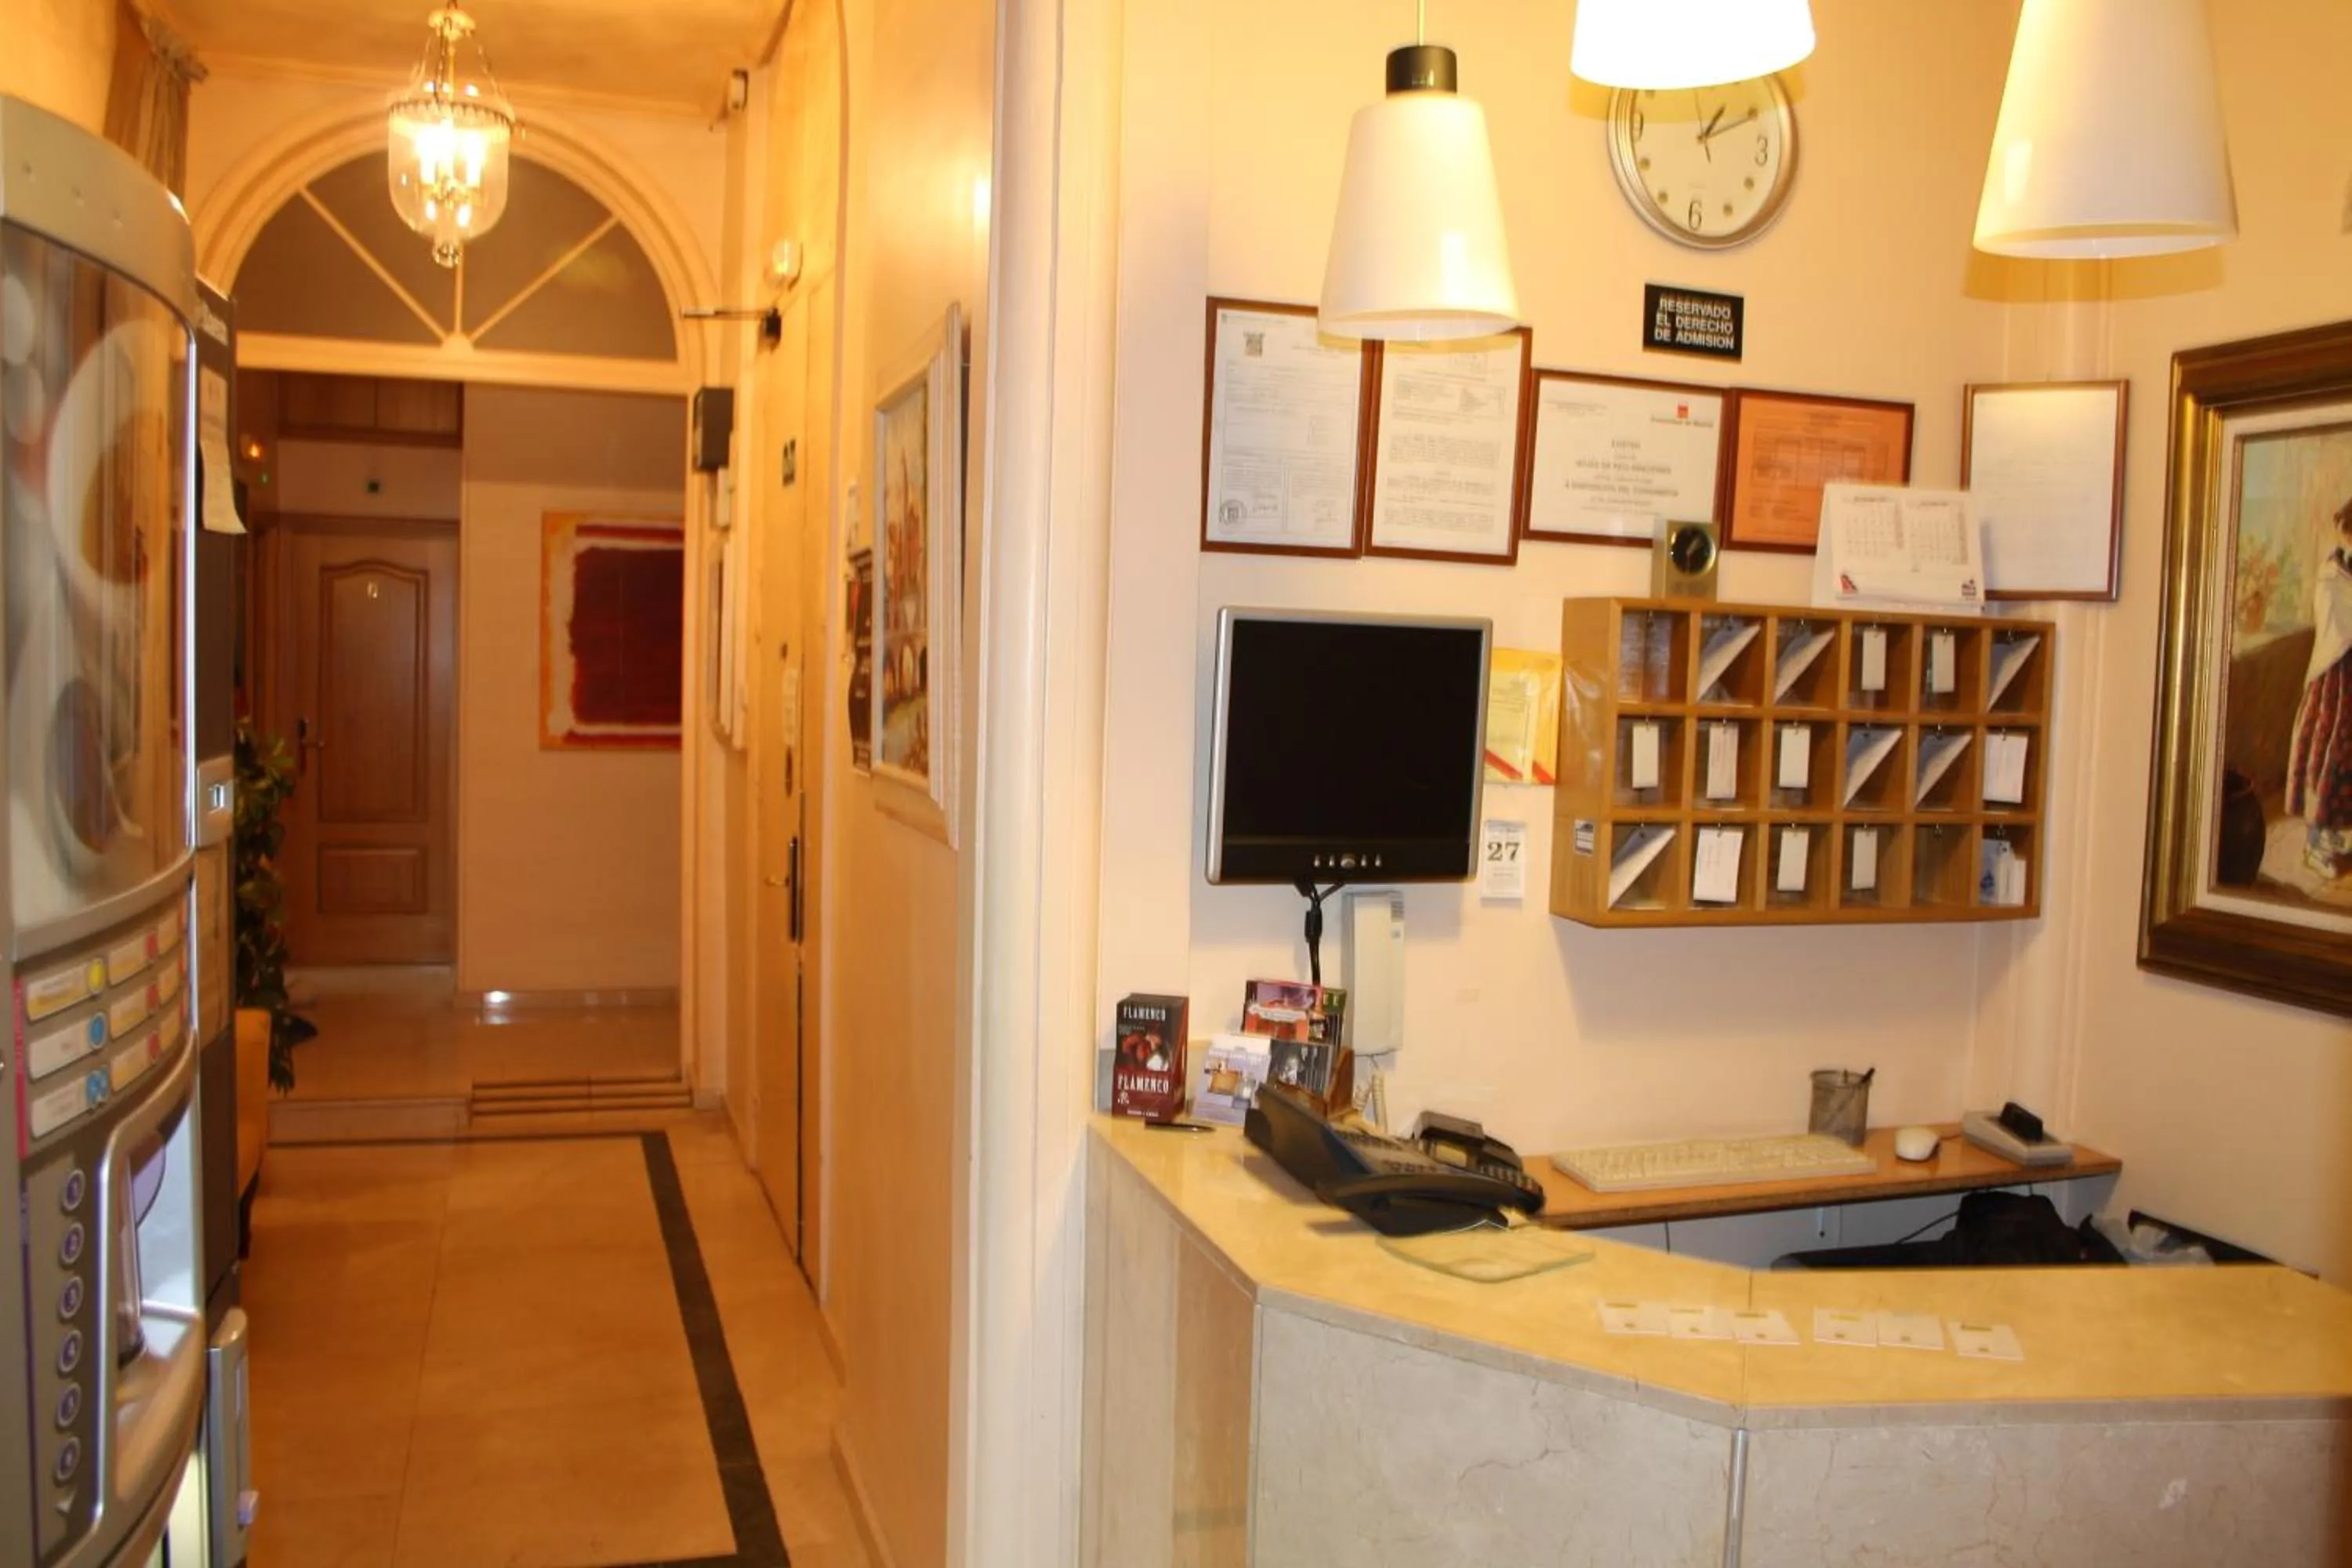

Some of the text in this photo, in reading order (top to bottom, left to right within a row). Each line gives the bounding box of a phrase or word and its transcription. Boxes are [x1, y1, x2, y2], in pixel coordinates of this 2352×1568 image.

[1755, 134, 1769, 166] 3
[1688, 199, 1703, 230] 6
[1658, 296, 1732, 320] RESERVADO
[1655, 311, 1733, 335] EL DERECHO
[1653, 327, 1671, 342] DE
[1486, 841, 1521, 862] 27
[1123, 1005, 1167, 1022] FLAMENCO
[1116, 1073, 1170, 1094] FLAMENCO
